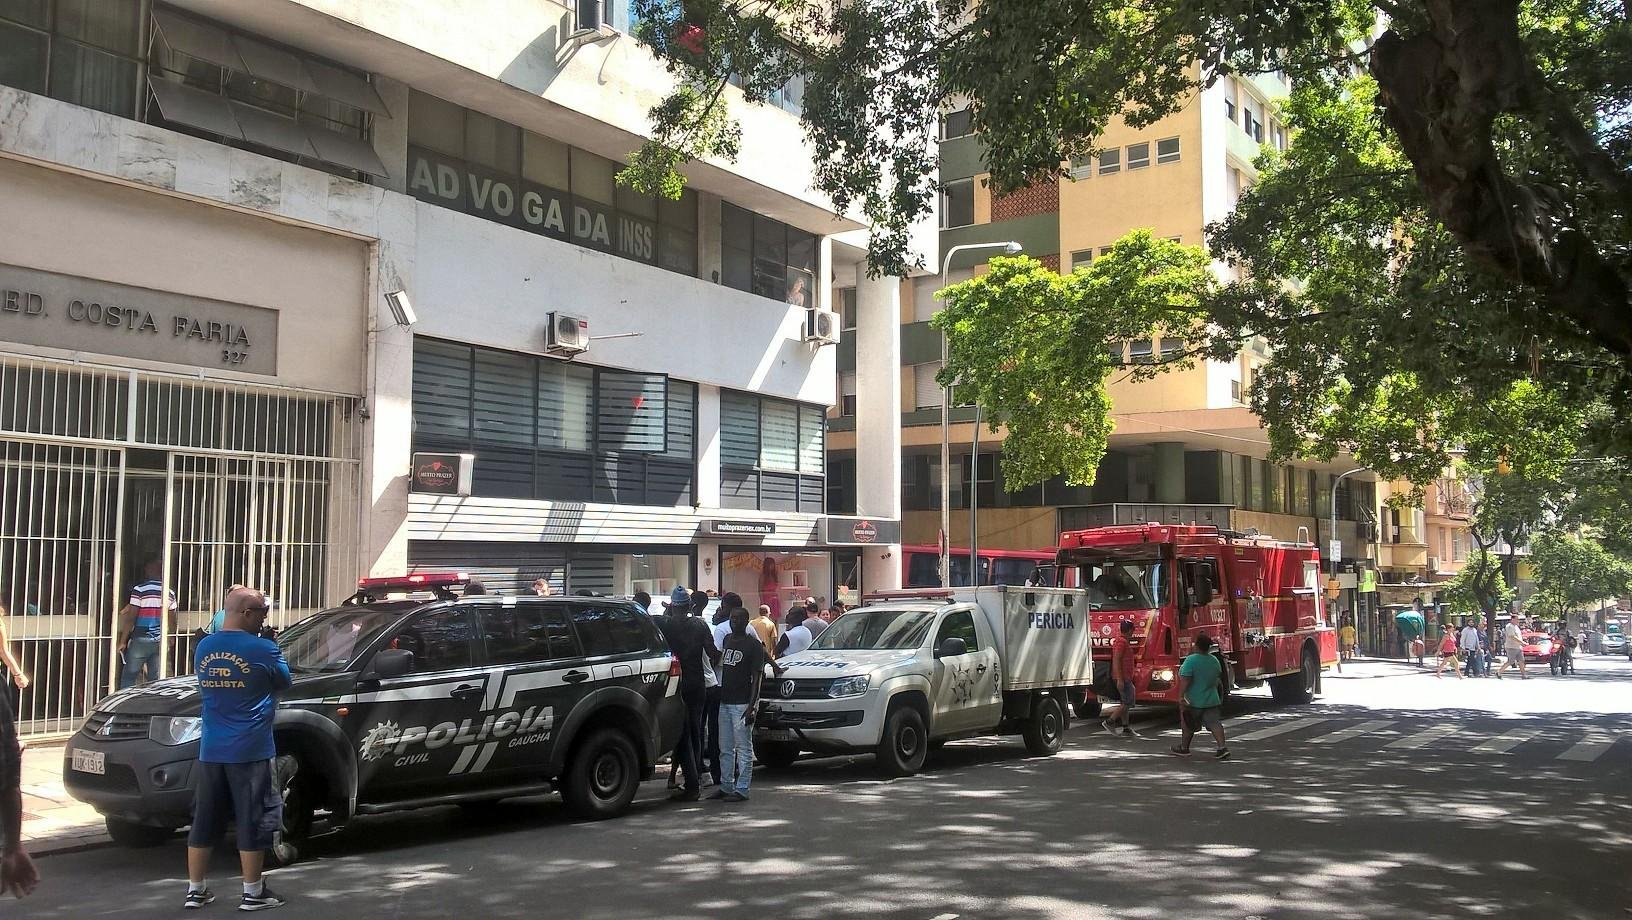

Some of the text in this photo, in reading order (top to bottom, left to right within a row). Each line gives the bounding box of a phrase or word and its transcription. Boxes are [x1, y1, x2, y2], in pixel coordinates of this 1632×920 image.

[618, 217, 652, 260] INSS
[2, 289, 251, 347] ED. COSTA FARIA
[222, 349, 249, 365] 327
[1028, 609, 1074, 629] PERÍCIA
[200, 651, 250, 674] FISCALIZAÇÃO
[721, 648, 744, 667] AP
[208, 667, 231, 677] EPTC
[201, 680, 246, 688] CICLISTA
[394, 731, 551, 767] CIVIL GAUCHA
